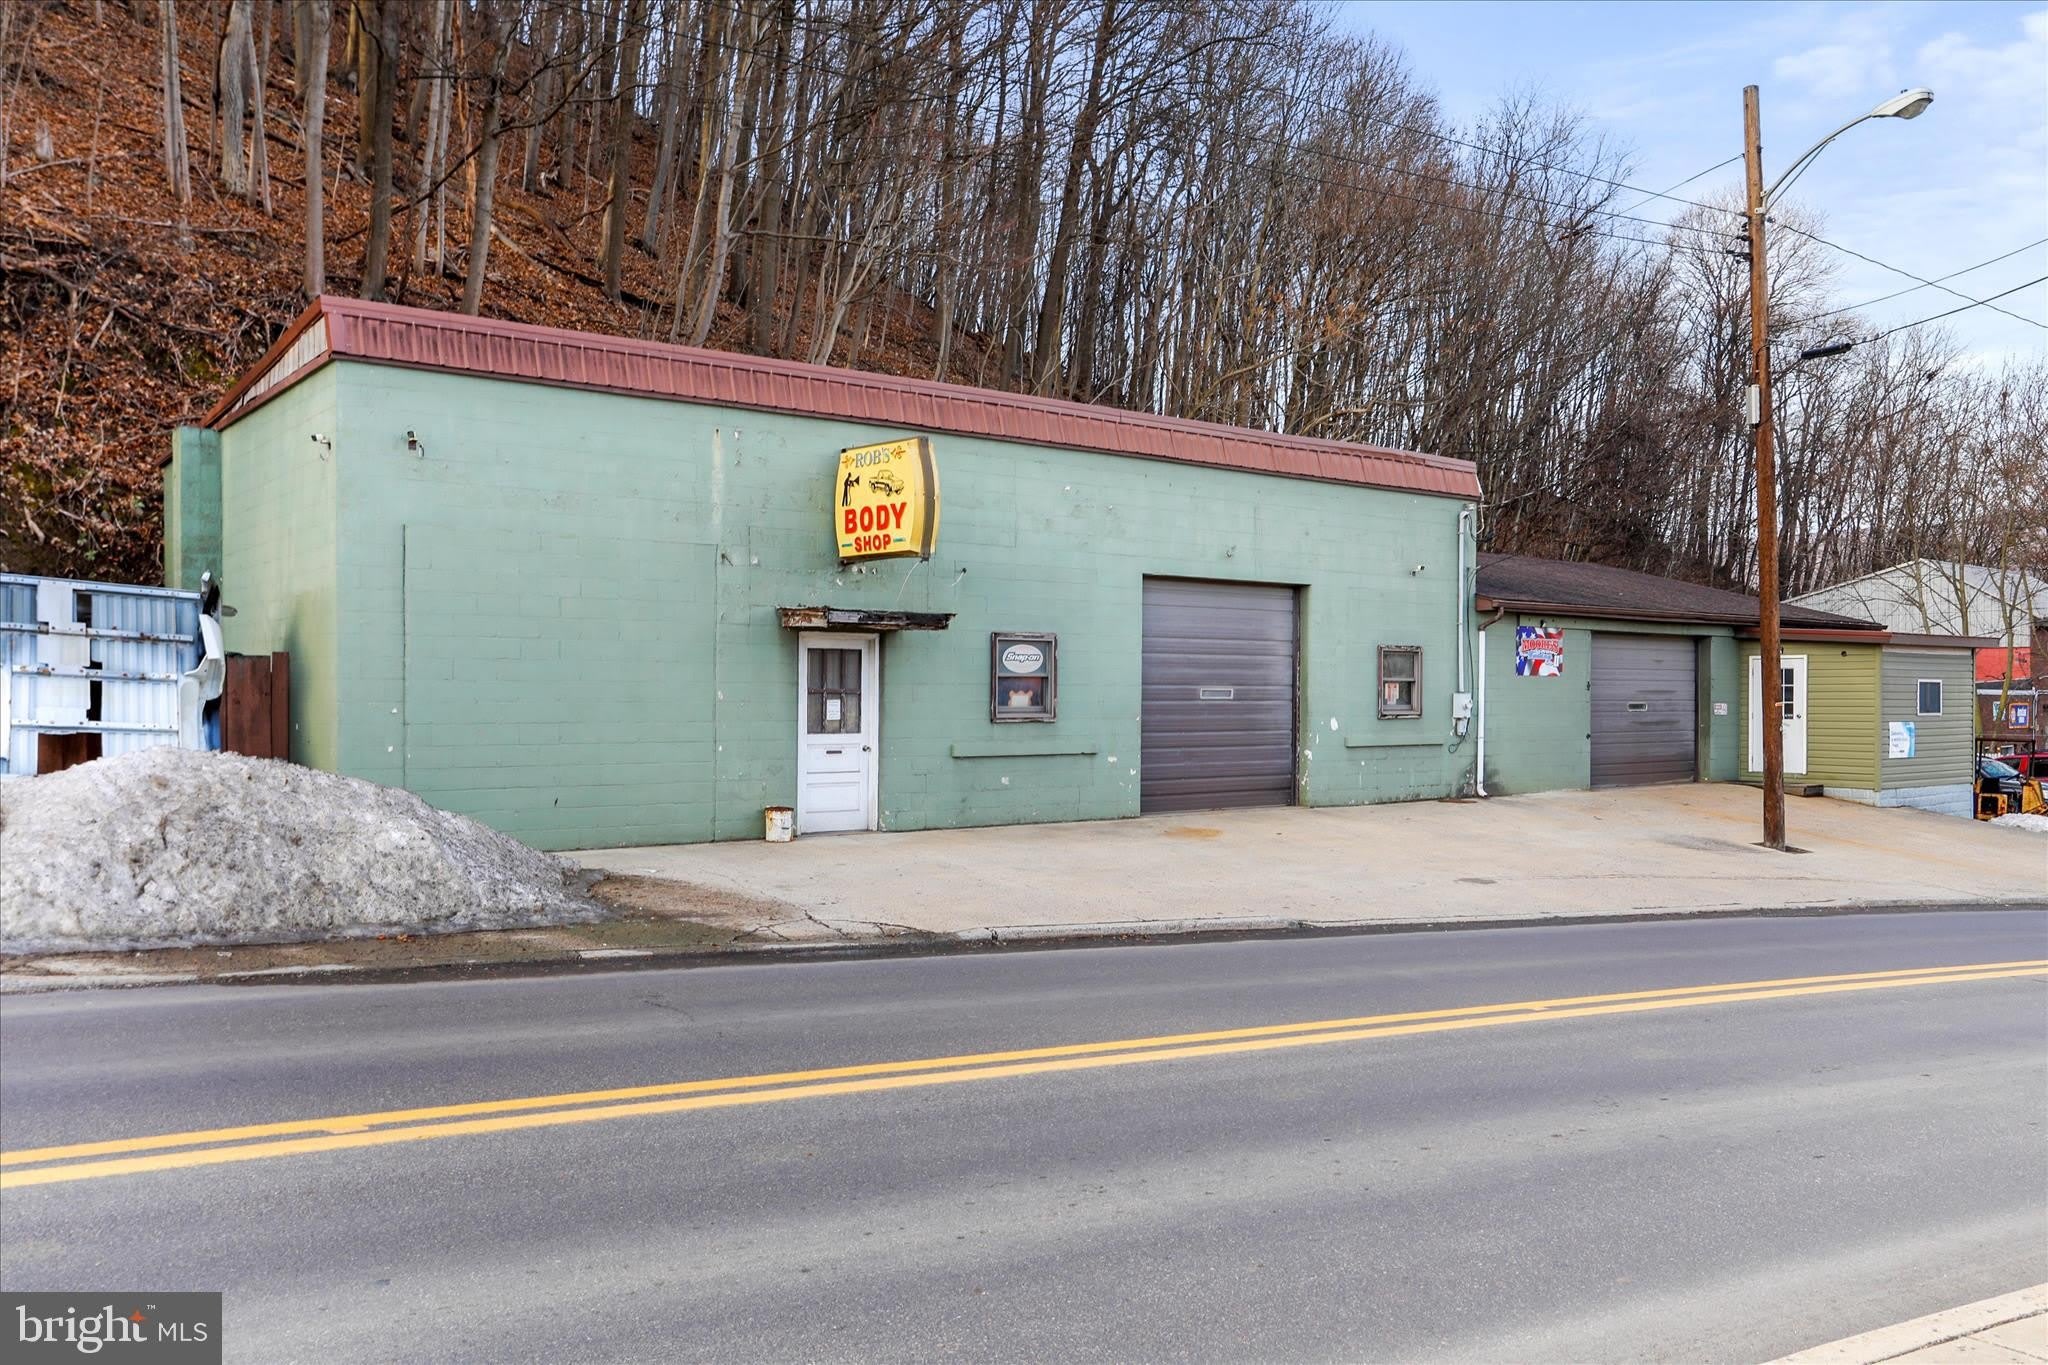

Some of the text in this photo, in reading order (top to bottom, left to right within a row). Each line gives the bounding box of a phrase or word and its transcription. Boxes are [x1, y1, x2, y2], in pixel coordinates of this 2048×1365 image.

[855, 447, 890, 468] ROB'S
[844, 502, 907, 534] BODY
[854, 533, 891, 552] SHOP
[1005, 652, 1041, 663] Snap-on
